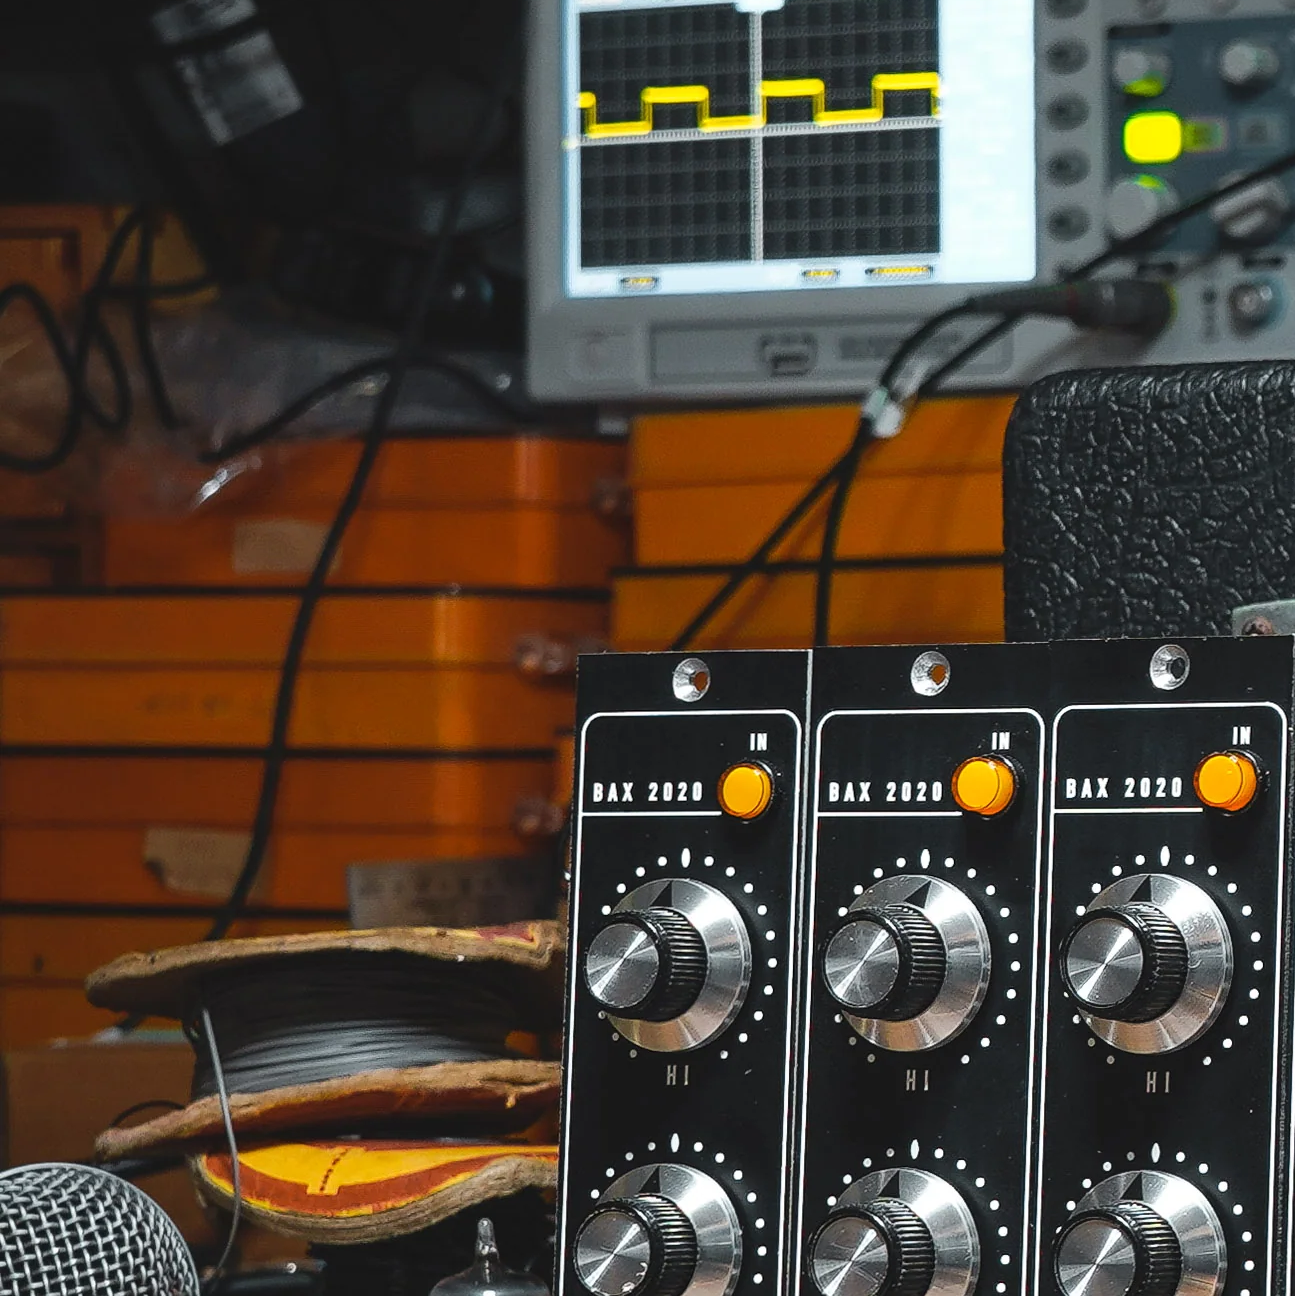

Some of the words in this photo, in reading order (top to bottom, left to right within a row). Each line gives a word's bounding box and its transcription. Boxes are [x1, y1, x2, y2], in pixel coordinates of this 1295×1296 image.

[749, 732, 768, 752] IN
[991, 731, 1011, 751] IN
[1232, 726, 1252, 746] IN
[592, 782, 634, 803] BAX
[647, 781, 703, 802] 2020
[828, 781, 871, 802] BAX
[885, 781, 943, 802] 2020
[1065, 777, 1109, 799] BAX
[1124, 776, 1183, 798] 2020
[666, 1064, 689, 1086] HI
[905, 1069, 929, 1092] HI
[1146, 1071, 1170, 1094] HI
